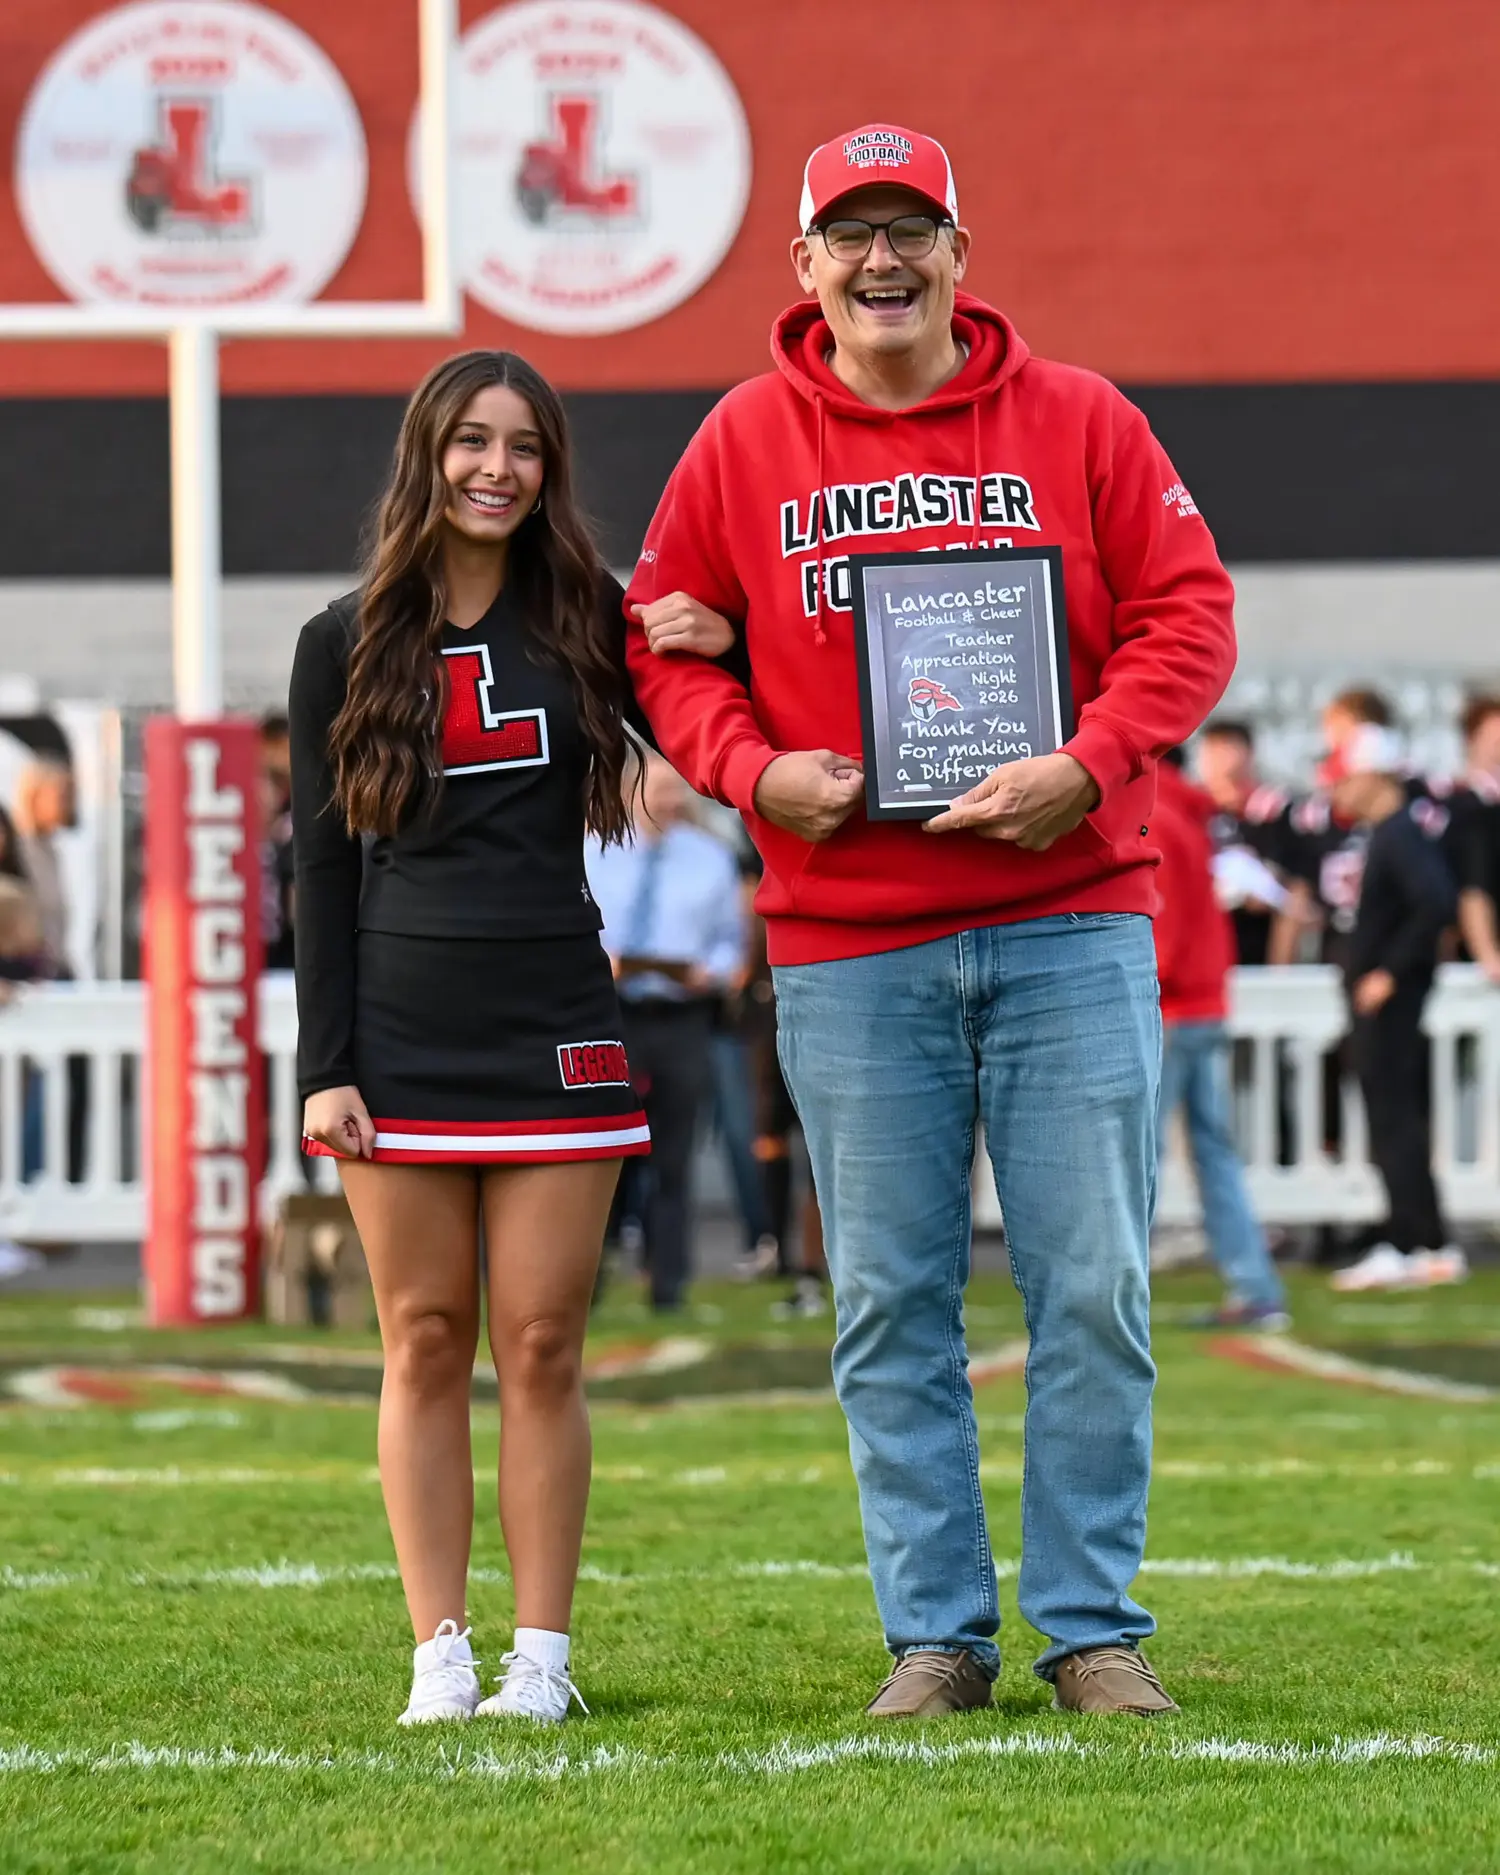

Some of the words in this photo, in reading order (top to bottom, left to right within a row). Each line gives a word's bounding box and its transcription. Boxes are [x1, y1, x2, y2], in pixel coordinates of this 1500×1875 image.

[843, 131, 913, 154] LANCASTER
[847, 147, 910, 166] FOOTBALL
[780, 472, 1041, 559] LANCASTER
[884, 581, 1026, 614] Lancaster
[895, 612, 955, 628] Football
[962, 609, 975, 624] &
[980, 607, 1022, 621] Cheer
[945, 631, 1014, 648] Teacher
[901, 650, 1016, 676] Appreciation
[971, 668, 1017, 690] Night
[979, 689, 1019, 705] 2026
[438, 644, 550, 777] L
[902, 720, 975, 739] Thank
[983, 715, 1027, 734] You
[899, 743, 938, 760] For
[948, 738, 1032, 760] making
[896, 770, 911, 781] a
[920, 757, 1001, 783] Differe
[186, 740, 248, 1316] LEGENDS
